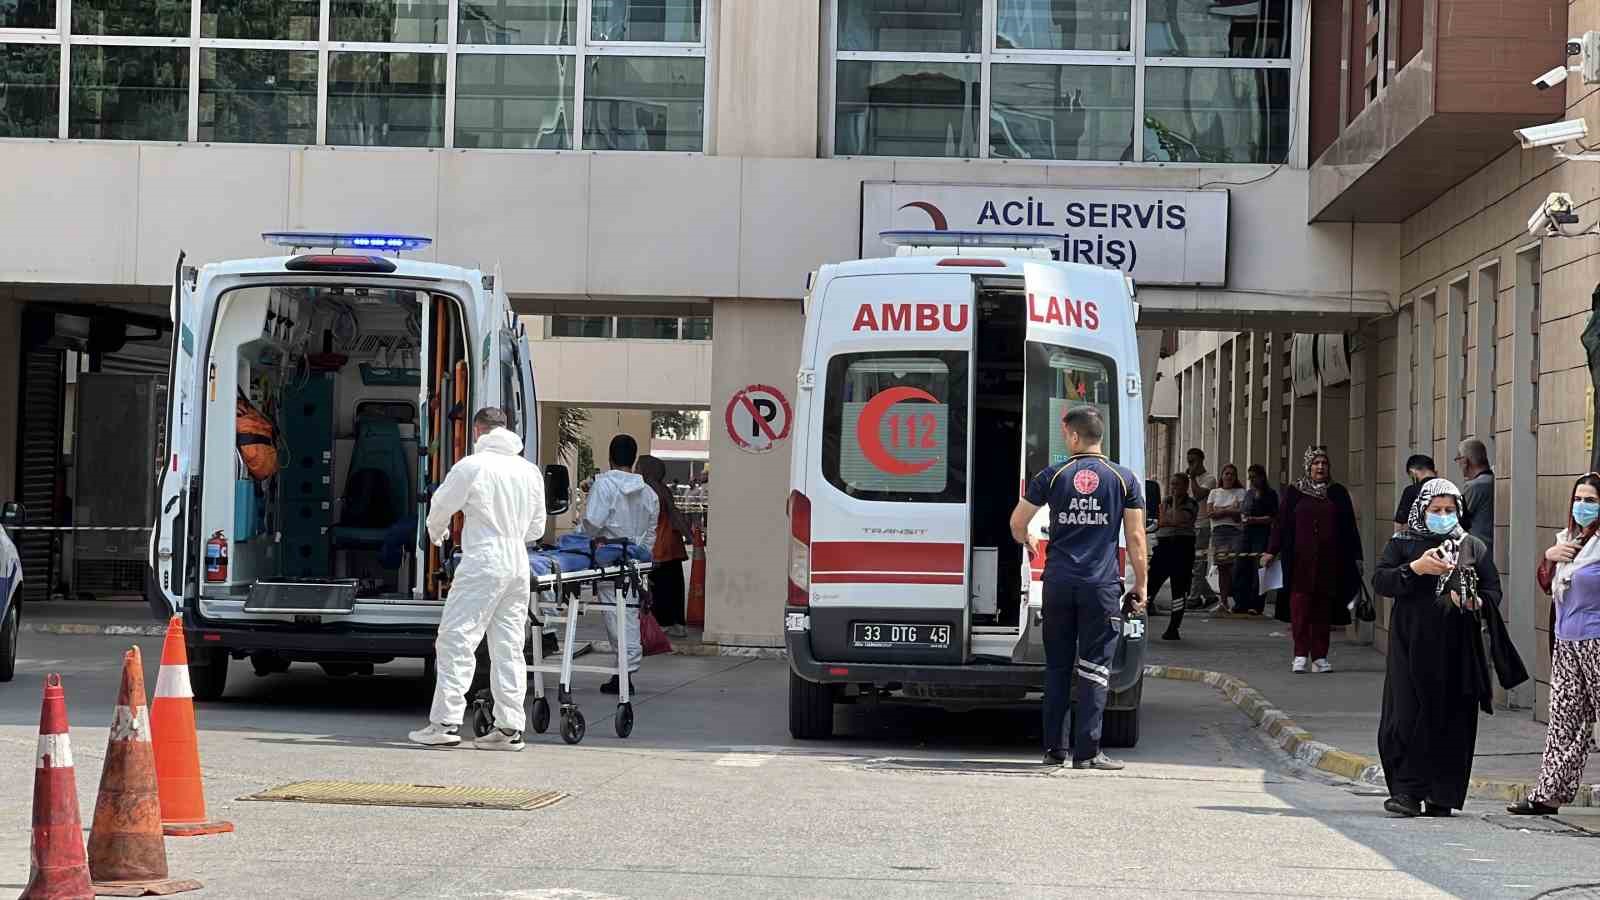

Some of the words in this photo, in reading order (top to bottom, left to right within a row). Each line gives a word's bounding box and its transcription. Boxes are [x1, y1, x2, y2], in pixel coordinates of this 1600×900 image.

[977, 196, 1055, 227] ACİL
[1065, 199, 1186, 230] SERVİS
[1051, 233, 1137, 272] İRİŞ)
[752, 398, 777, 437] P
[887, 411, 938, 449] 112
[1058, 510, 1109, 525] SAĞLIK
[1068, 496, 1101, 511] ACİL
[864, 626, 881, 641] 33
[891, 626, 917, 642] DTG
[929, 627, 947, 643] 45
